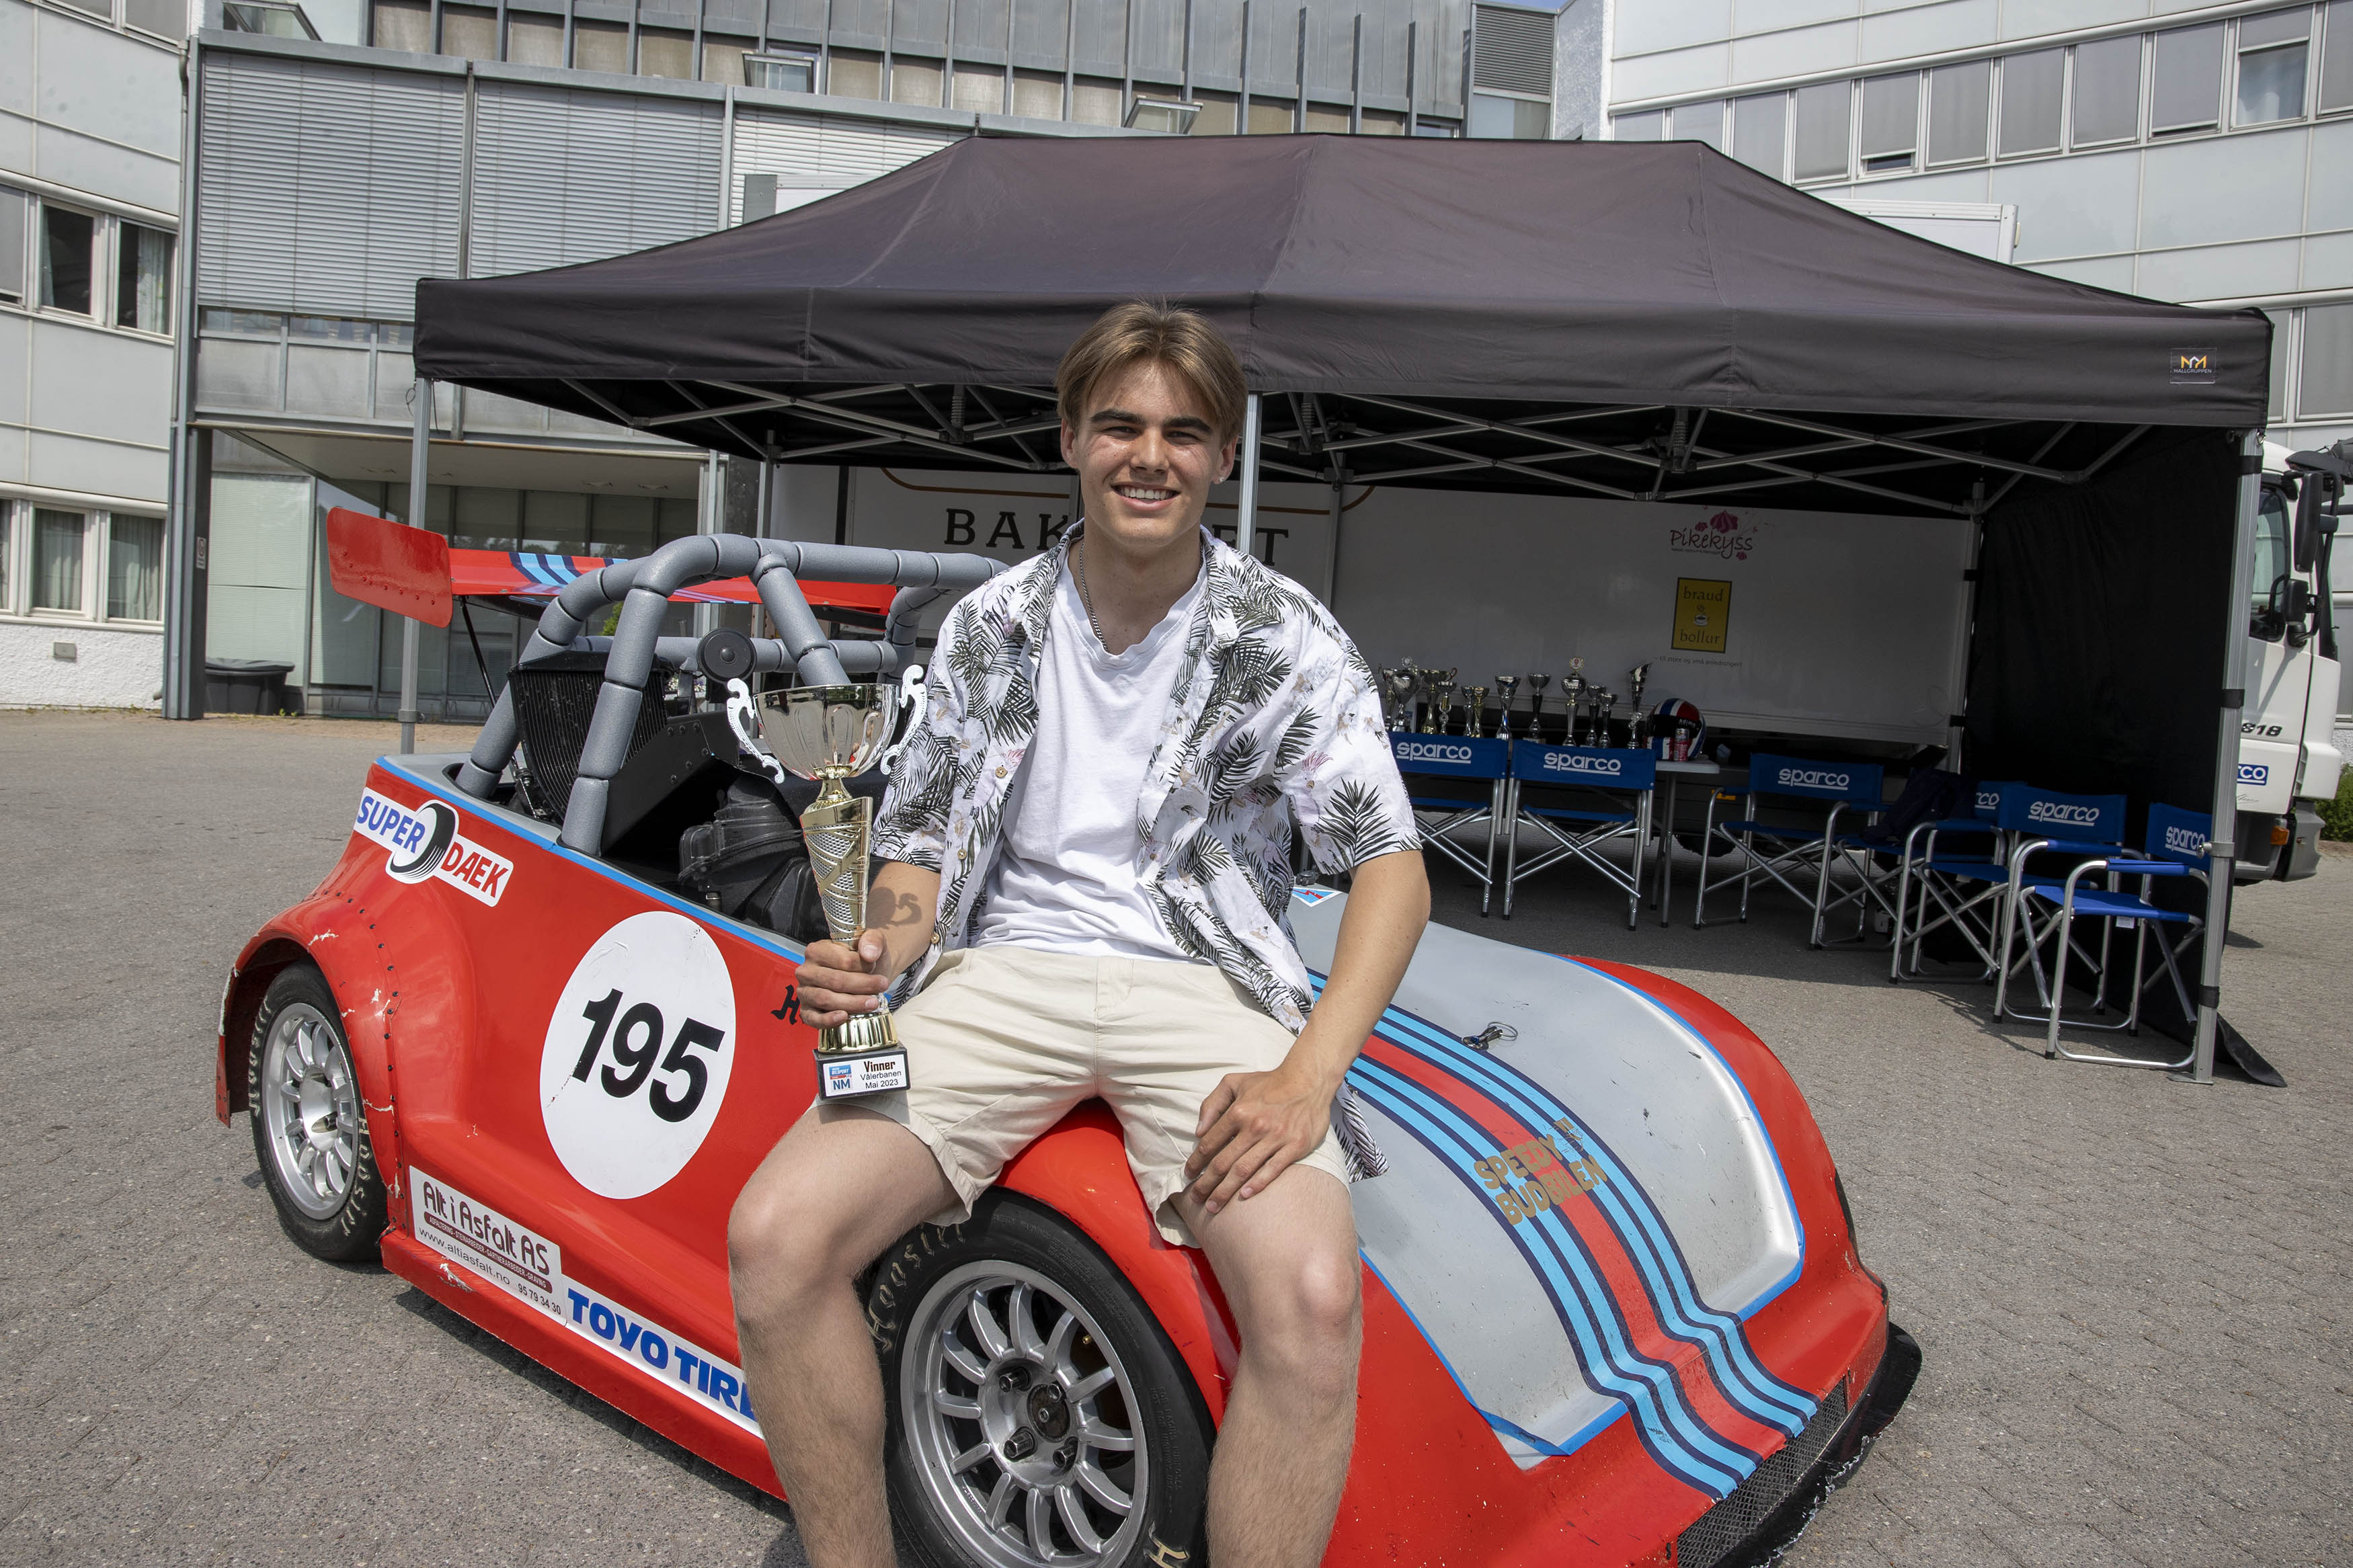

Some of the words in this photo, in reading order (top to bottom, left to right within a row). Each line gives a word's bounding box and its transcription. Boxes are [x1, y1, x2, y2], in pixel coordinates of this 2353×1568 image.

[1670, 528, 1753, 559] Pikekyss
[1683, 586, 1723, 602] braud
[1680, 629, 1720, 645] bollur
[1396, 741, 1472, 763] sparco
[1544, 752, 1622, 774] sparco
[1778, 768, 1849, 789] sparco
[357, 796, 425, 854] SUPER
[2029, 801, 2100, 825] sparco
[2165, 826, 2205, 854] sparco
[571, 988, 725, 1123] 195
[864, 1061, 895, 1073] Vinner
[833, 1079, 850, 1090] NM
[861, 1071, 902, 1081] Vålerbanen
[881, 1079, 899, 1087] 2023
[1474, 1134, 1563, 1190] SPEEDY
[1495, 1155, 1608, 1225] BUDBILEN
[423, 1181, 447, 1219] Alt
[450, 1196, 456, 1224] i
[460, 1201, 517, 1259] Asfalt
[520, 1235, 550, 1276] AS
[419, 1227, 510, 1285] www.altiasfalt.no
[518, 1283, 528, 1296] 95
[528, 1289, 539, 1302] 79
[540, 1296, 550, 1309] 34
[551, 1302, 561, 1315] 30
[568, 1288, 669, 1370] TOYO
[675, 1346, 758, 1422] TIR
